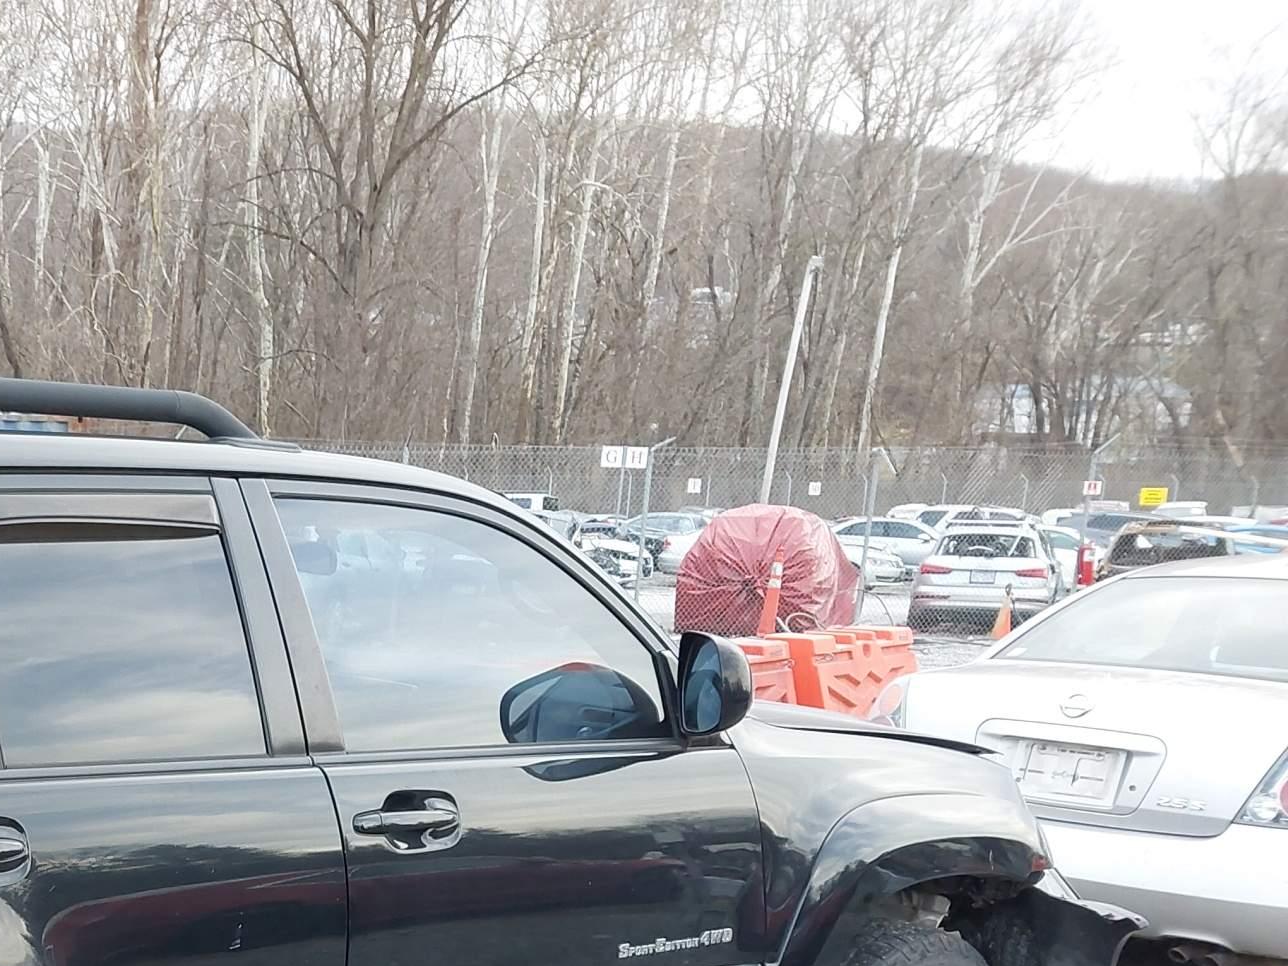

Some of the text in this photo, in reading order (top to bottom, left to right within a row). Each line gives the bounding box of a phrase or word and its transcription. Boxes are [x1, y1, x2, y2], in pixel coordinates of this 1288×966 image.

[606, 450, 617, 463] G
[631, 450, 642, 464] H
[700, 927, 733, 946] 4WD
